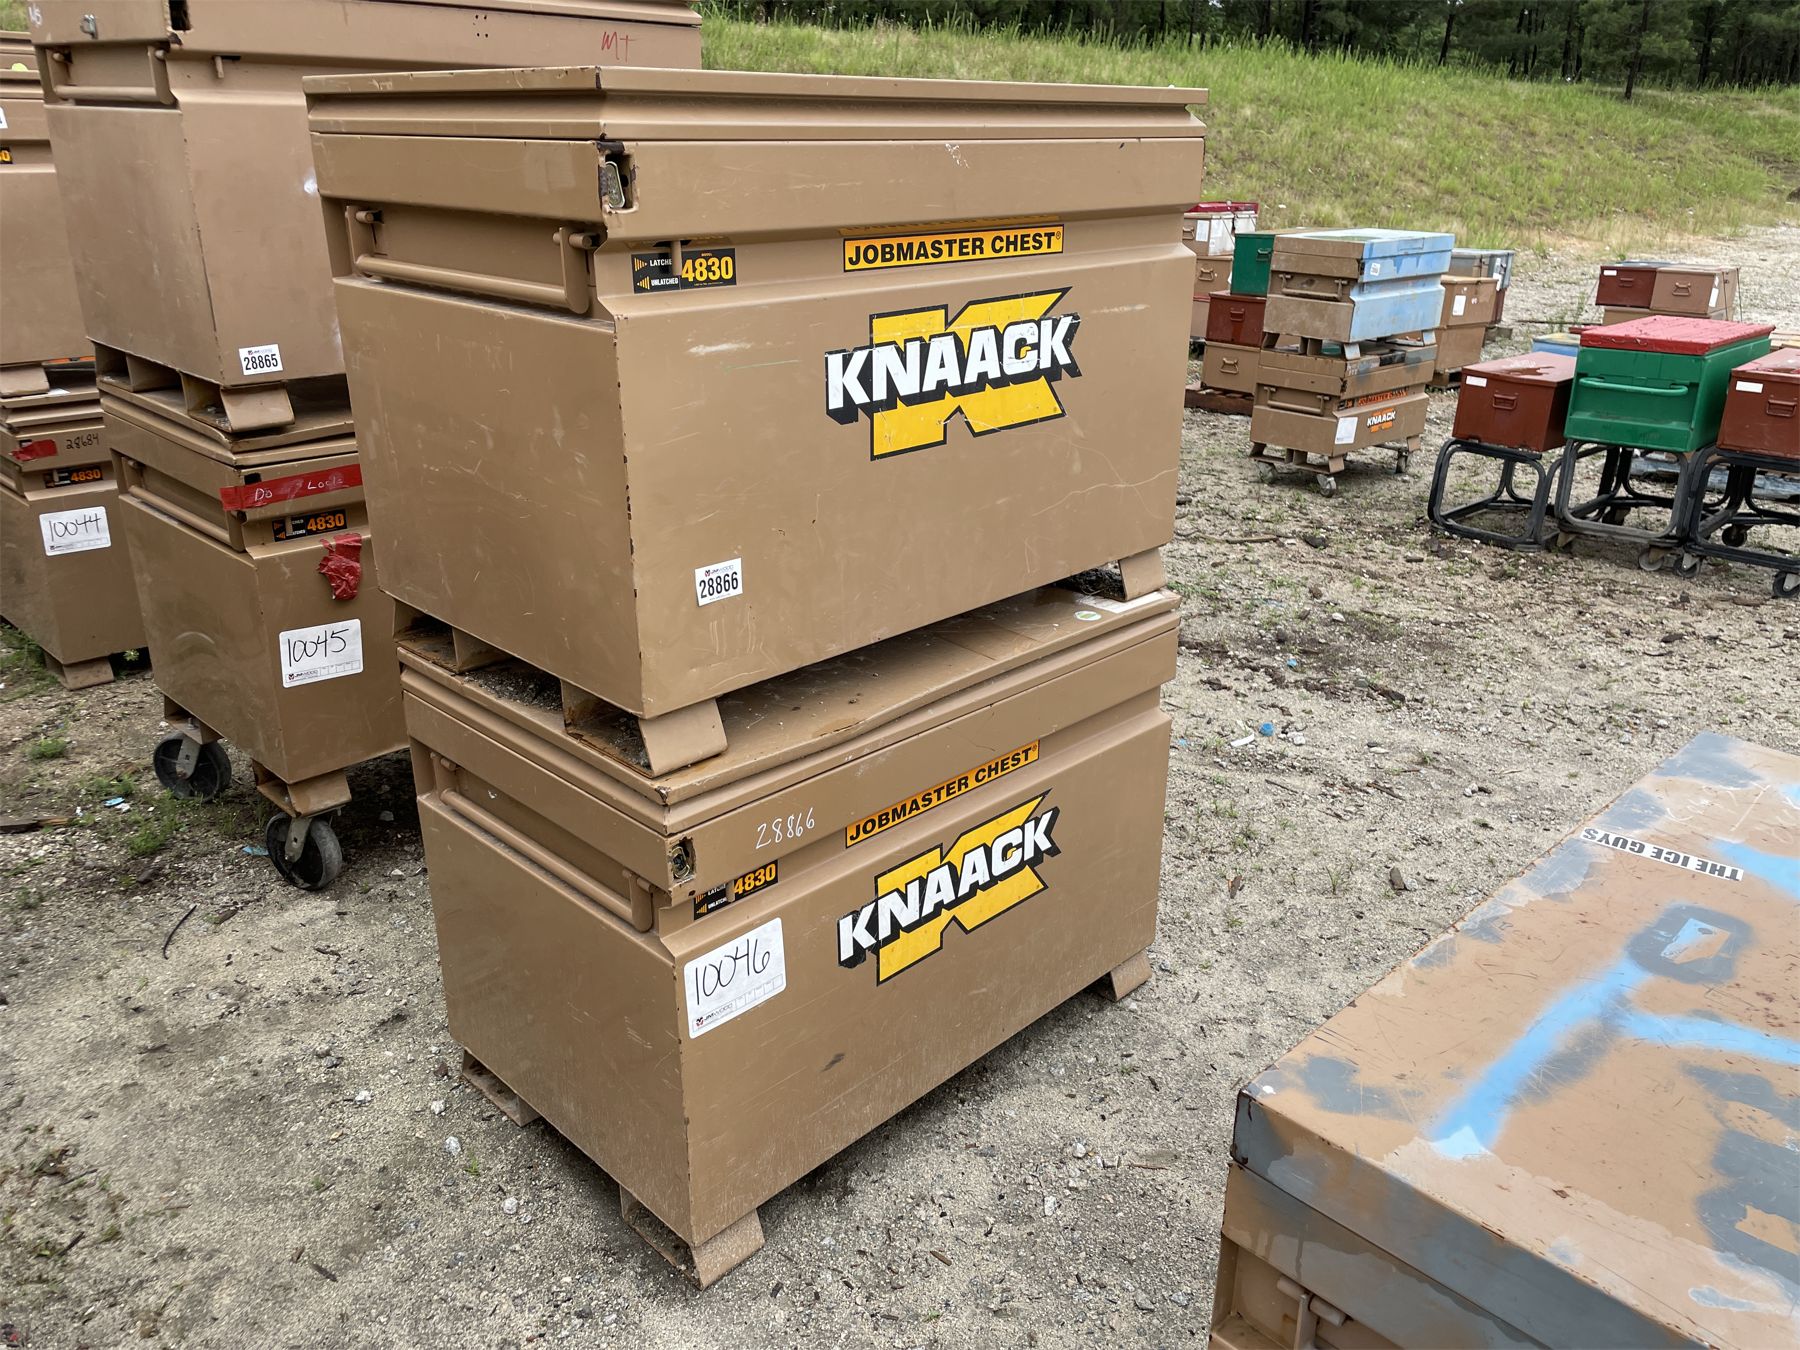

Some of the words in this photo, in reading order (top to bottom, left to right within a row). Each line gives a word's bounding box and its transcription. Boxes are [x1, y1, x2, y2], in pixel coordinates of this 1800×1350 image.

[649, 258, 673, 267] LATCHE
[848, 236, 985, 266] JOBMASTER
[681, 256, 734, 282] 4830
[243, 353, 279, 371] 28865
[826, 313, 1081, 418] KNAACK
[1366, 410, 1397, 427] KNAACK
[65, 432, 101, 450] 28684
[71, 468, 102, 482] 4830
[48, 512, 102, 542] 10044
[306, 513, 346, 532] 4830
[699, 571, 739, 599] 28866
[287, 628, 350, 668] 10045
[849, 775, 969, 841] JOBMASTER
[755, 807, 816, 850] 28866
[1582, 827, 1646, 855] GUYS
[1649, 846, 1691, 868] ICE
[1694, 859, 1740, 881] THE
[732, 862, 777, 895] 4830
[838, 808, 1059, 966] KNAACK
[695, 938, 771, 1006] 10046
